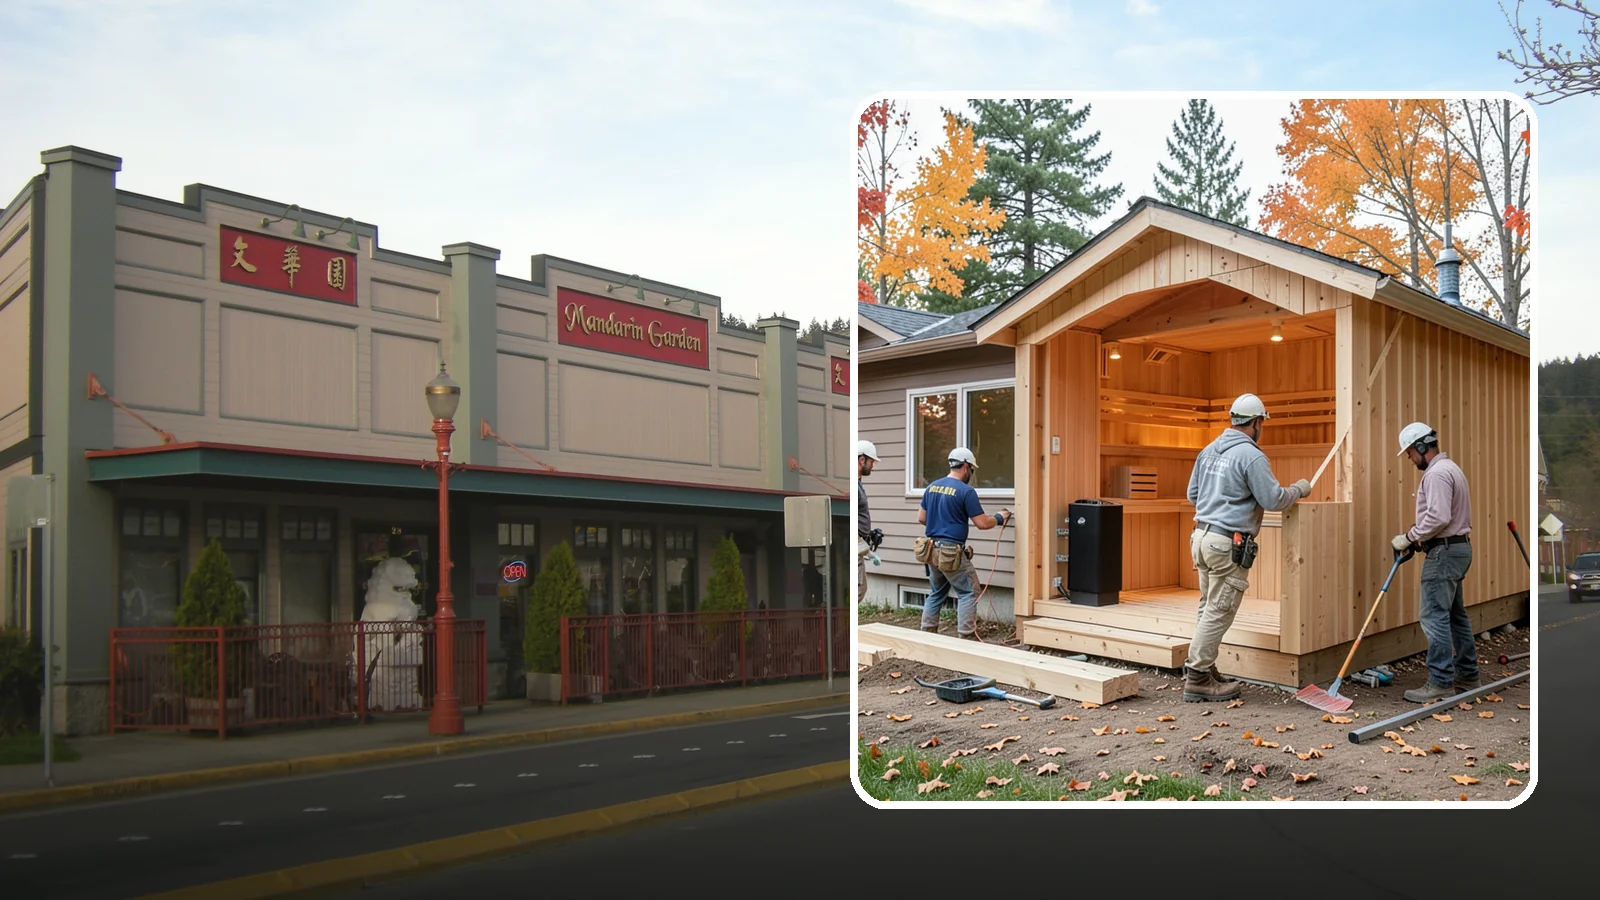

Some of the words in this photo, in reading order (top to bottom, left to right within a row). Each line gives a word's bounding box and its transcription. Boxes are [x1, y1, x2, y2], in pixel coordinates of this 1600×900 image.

[230, 235, 346, 291] 文華園
[564, 302, 644, 341] Mandarin
[648, 320, 701, 352] Garden
[503, 565, 527, 578] OPEN
